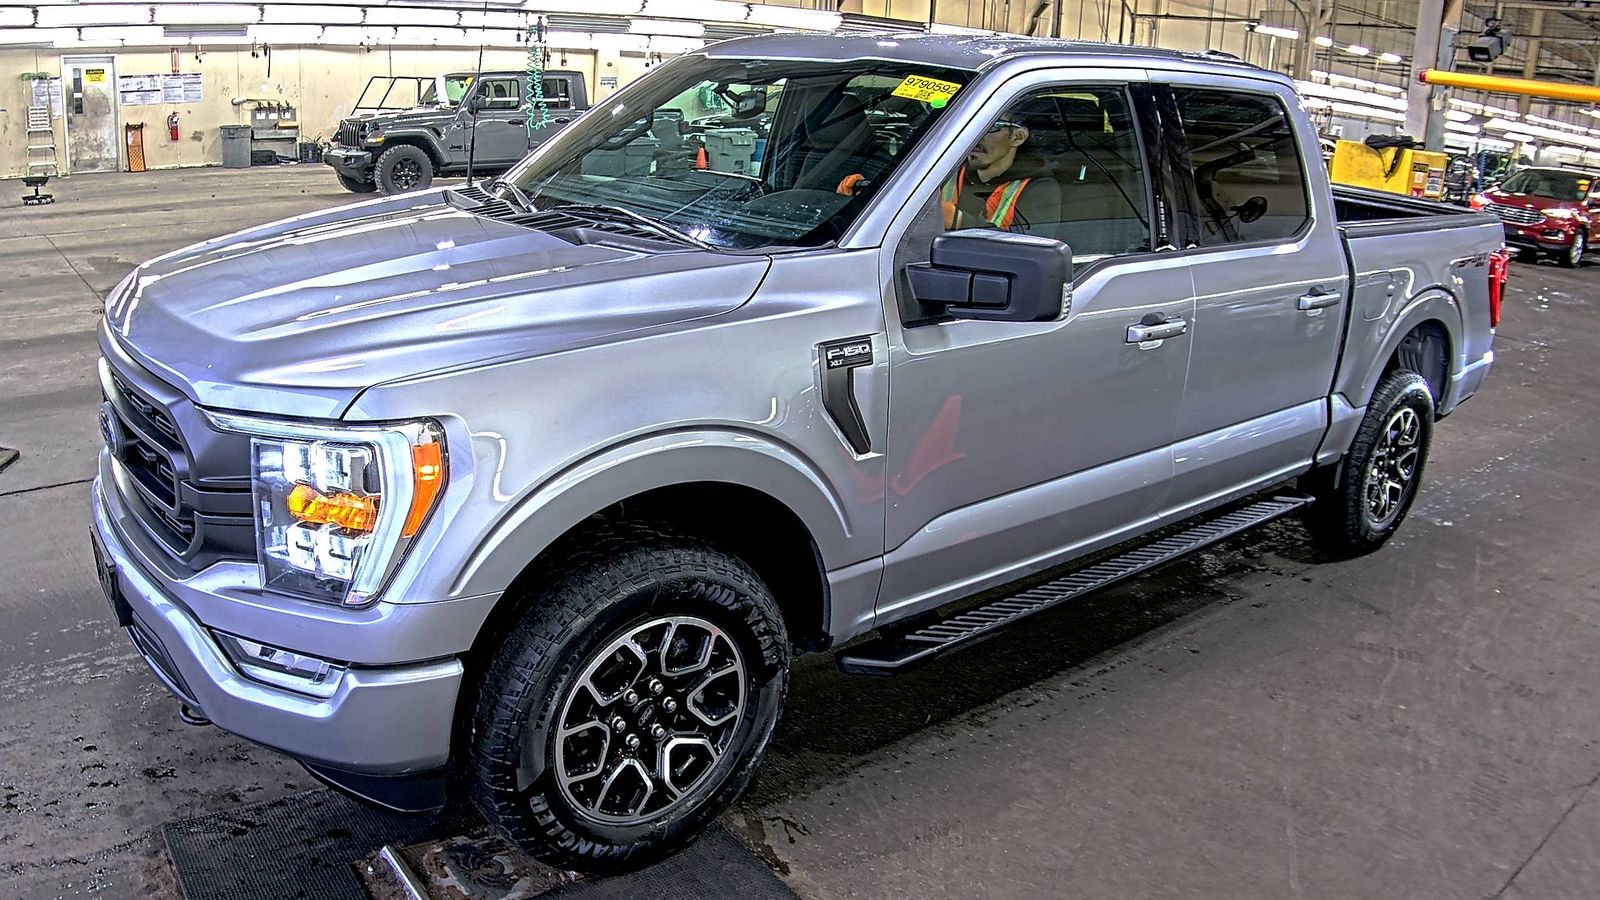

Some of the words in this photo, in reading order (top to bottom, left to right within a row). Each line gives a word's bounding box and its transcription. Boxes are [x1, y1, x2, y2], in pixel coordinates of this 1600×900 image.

[905, 77, 958, 94] 9790592
[827, 344, 870, 360] F-150
[830, 359, 843, 367] XLT
[529, 792, 636, 860] RANGLER
